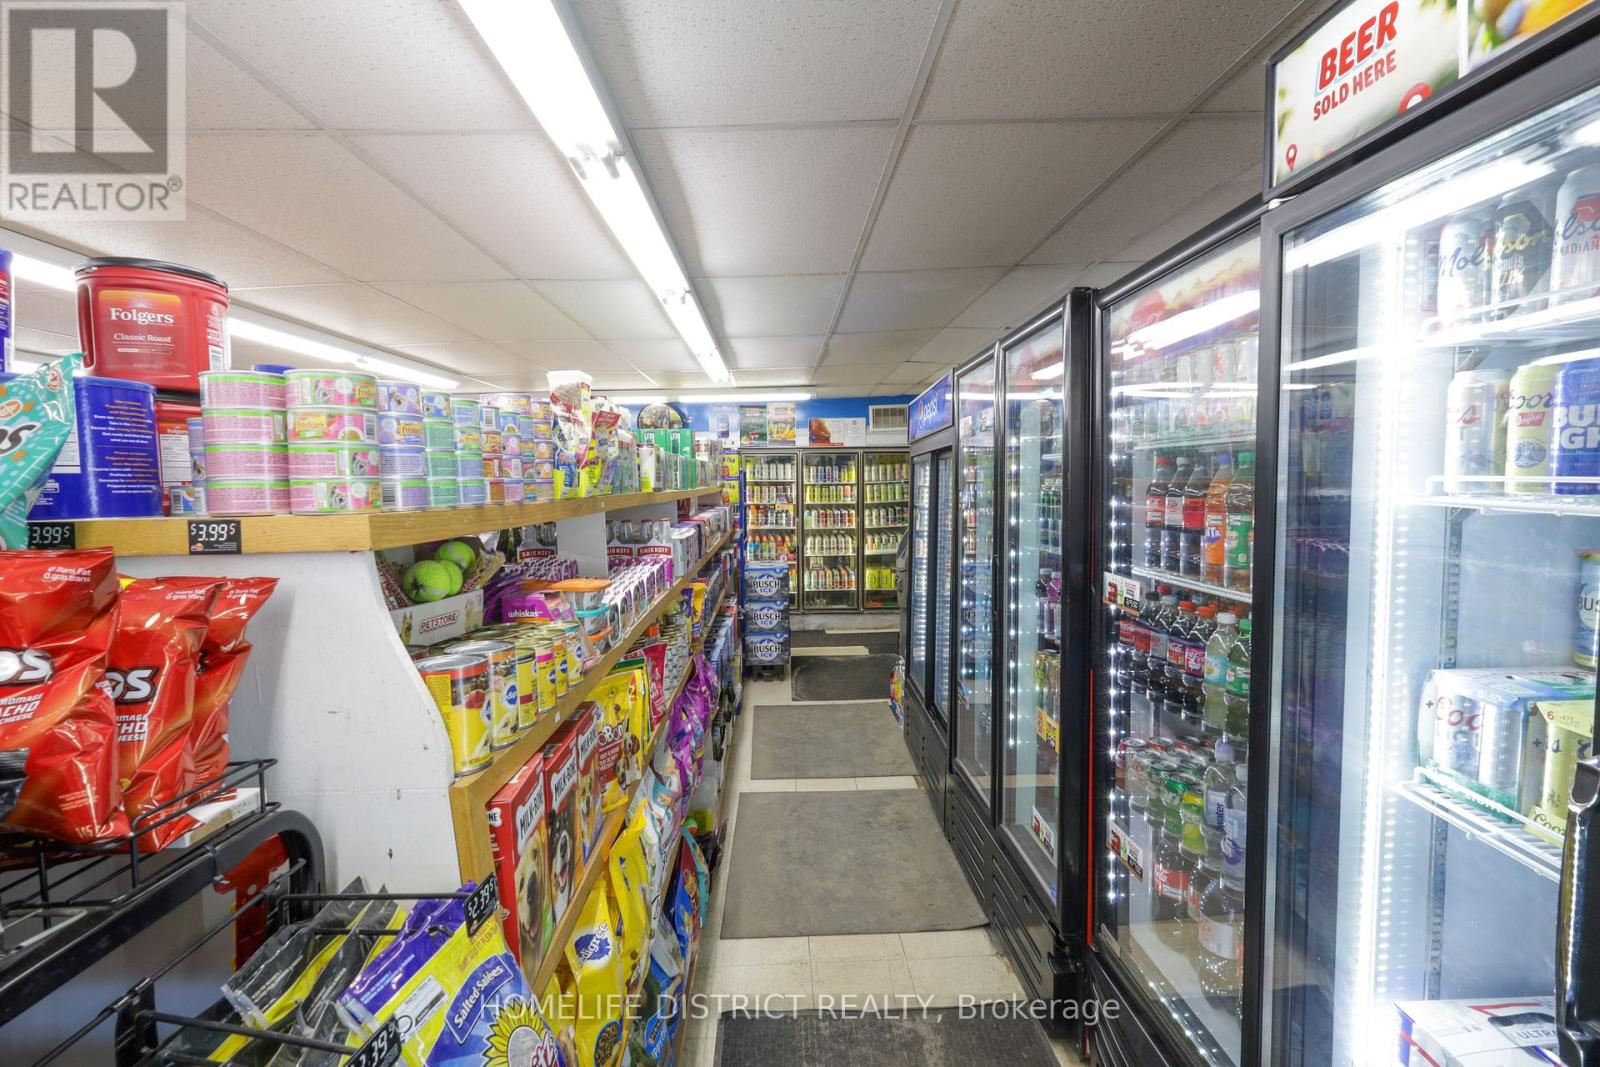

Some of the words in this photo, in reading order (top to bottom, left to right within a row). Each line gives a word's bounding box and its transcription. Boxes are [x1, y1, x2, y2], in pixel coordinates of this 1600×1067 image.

[1317, 1, 1399, 91] BEER
[1313, 84, 1349, 121] SOLD
[1353, 49, 1397, 96] HERE
[110, 307, 174, 325] Folgers
[114, 333, 145, 343] Classic
[147, 334, 173, 344] Roast
[923, 396, 938, 423] pepsi
[752, 580, 780, 589] BUSCH
[508, 609, 540, 618] whiskas
[753, 613, 781, 621] BUSCH
[753, 645, 781, 654] BUSCH
